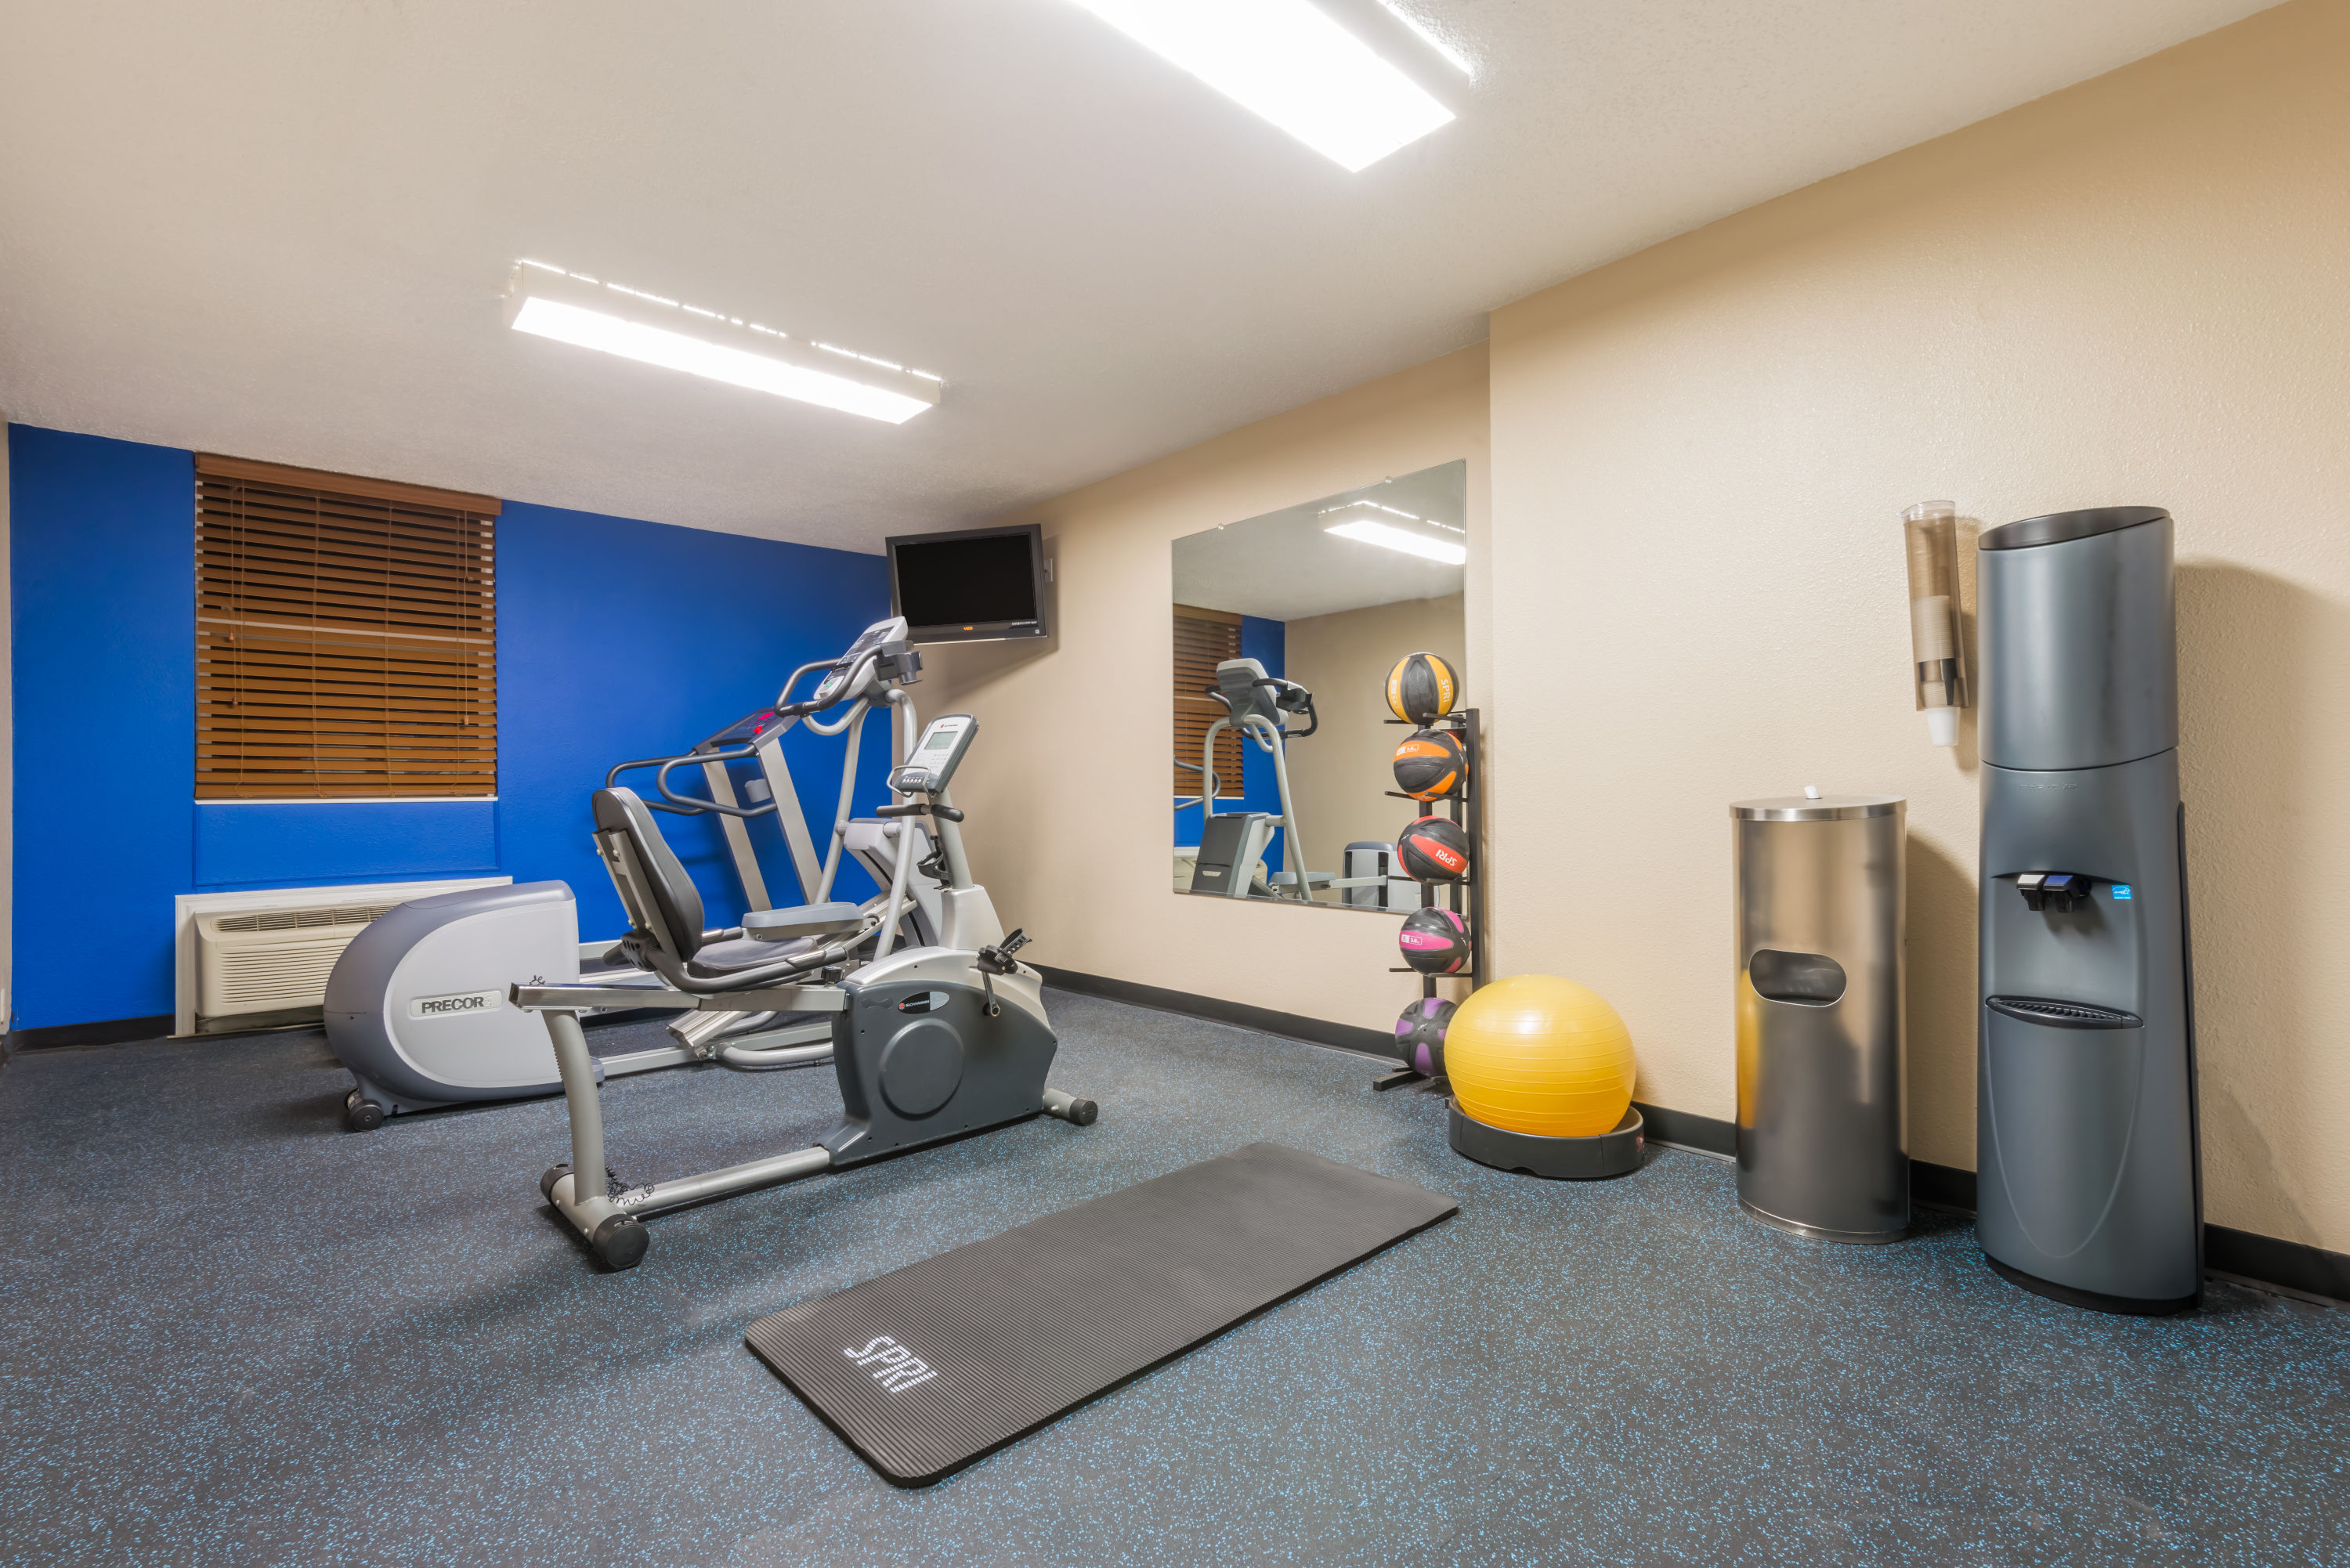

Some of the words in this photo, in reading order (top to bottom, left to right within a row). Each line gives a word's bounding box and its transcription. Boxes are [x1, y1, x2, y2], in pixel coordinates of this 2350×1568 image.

[1441, 678, 1451, 703] SPRI
[1435, 849, 1458, 866] SPRI
[421, 996, 485, 1013] PRECOR
[844, 1335, 938, 1393] SPRI
